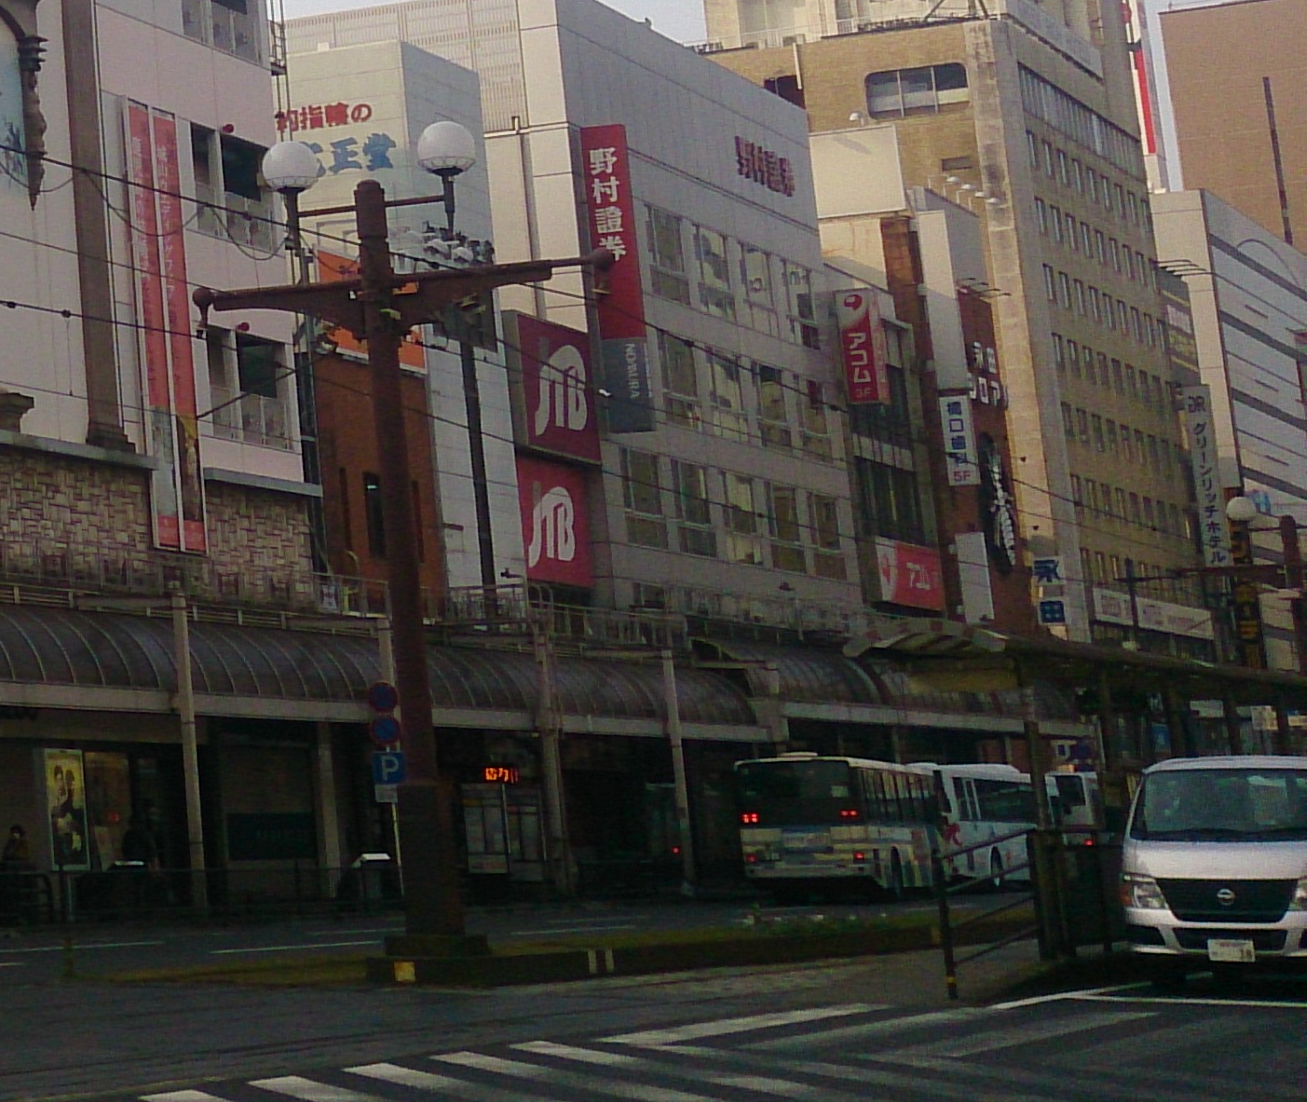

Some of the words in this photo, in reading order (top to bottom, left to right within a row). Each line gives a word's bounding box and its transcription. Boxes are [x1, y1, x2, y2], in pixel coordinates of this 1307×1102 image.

[299, 132, 397, 178] 正堂
[847, 331, 872, 384] アコム
[535, 336, 588, 437] JTB
[953, 470, 972, 482] 5F
[528, 480, 576, 569] JTB
[381, 754, 400, 781] P
